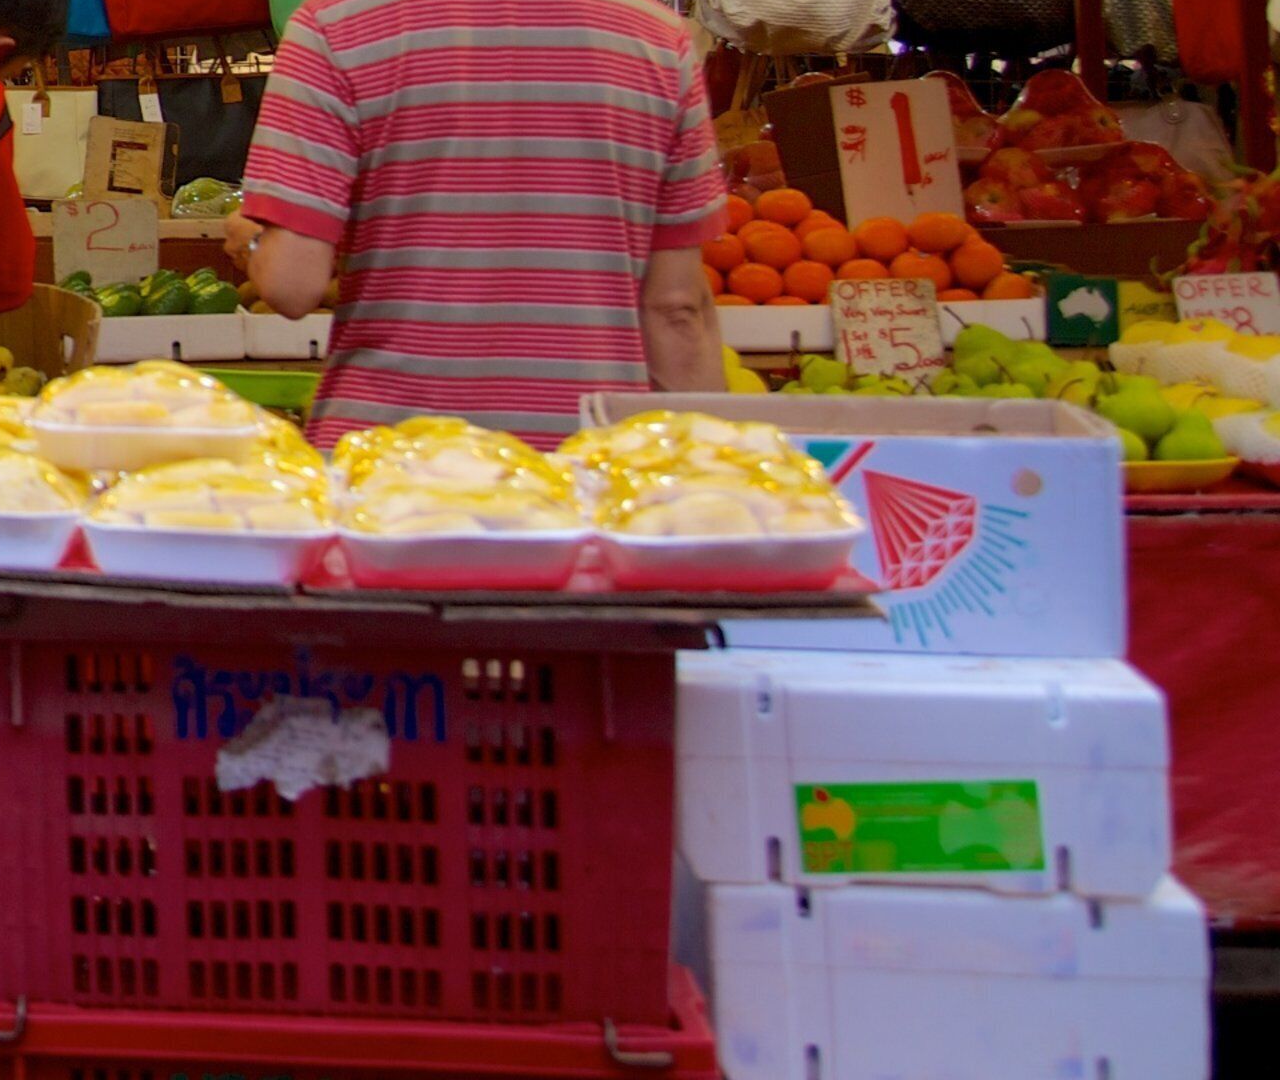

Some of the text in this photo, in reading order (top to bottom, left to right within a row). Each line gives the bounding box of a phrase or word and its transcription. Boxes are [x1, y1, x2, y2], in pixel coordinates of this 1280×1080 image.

[66, 201, 125, 252] $2
[837, 280, 926, 300] OFFER
[1176, 276, 1272, 300] OFFER
[842, 305, 868, 323] Very
